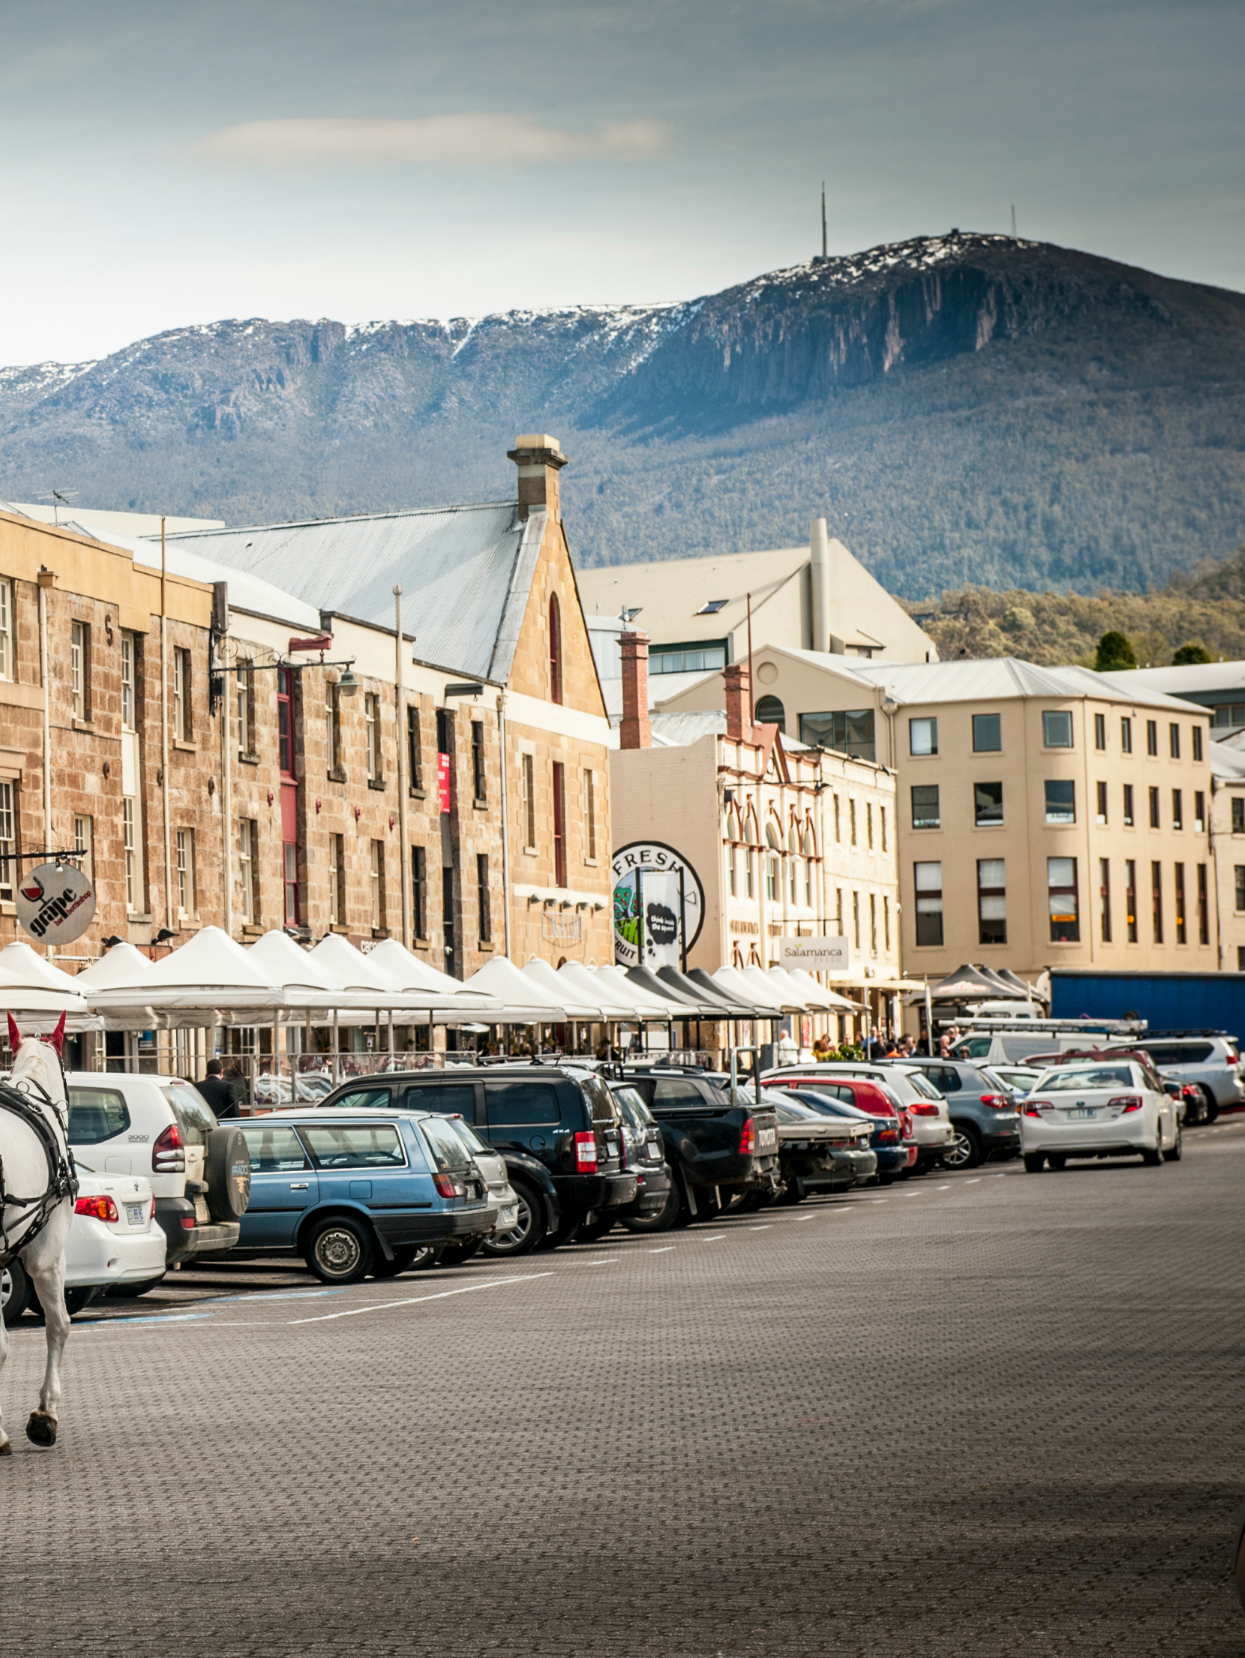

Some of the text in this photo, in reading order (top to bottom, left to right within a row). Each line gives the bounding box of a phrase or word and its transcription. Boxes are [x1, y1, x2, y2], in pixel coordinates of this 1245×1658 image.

[30, 888, 77, 937] grape
[54, 890, 91, 926] bar bottleshop
[615, 940, 636, 959] RUIT
[784, 947, 843, 958] Salamanca
